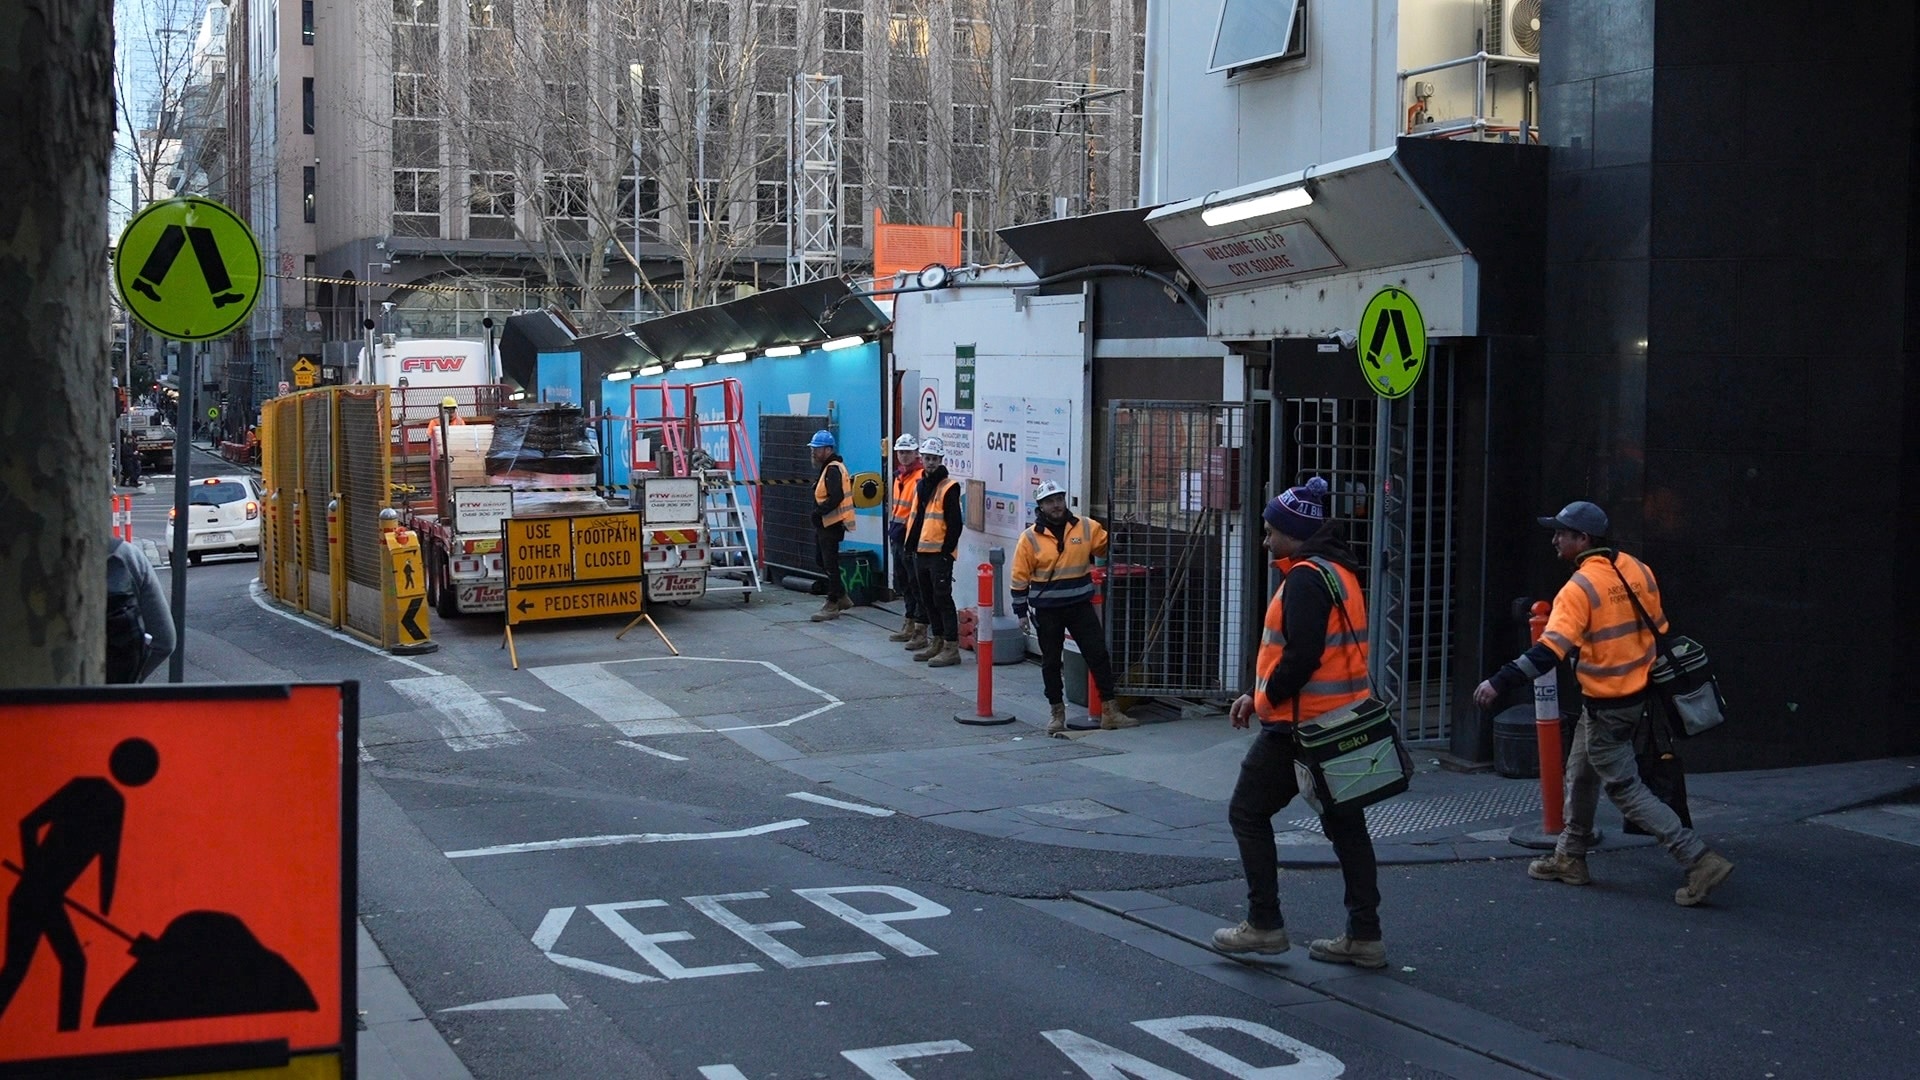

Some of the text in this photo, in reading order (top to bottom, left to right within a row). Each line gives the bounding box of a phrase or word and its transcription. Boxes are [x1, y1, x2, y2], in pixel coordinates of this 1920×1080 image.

[1203, 233, 1287, 261] WELCOME TO CYP
[1228, 254, 1294, 277] CITY SQUARE
[401, 355, 468, 373] FTW
[926, 398, 932, 422] 5
[944, 416, 966, 427] NOTICE
[987, 431, 1016, 453] GATE
[998, 463, 1003, 481] 1
[526, 524, 551, 539] USE
[577, 527, 637, 545] FOOTPATH
[518, 544, 561, 560] OTHER
[585, 550, 631, 568] CLOSED
[511, 563, 571, 581] FOOTPATH
[663, 575, 702, 591] TUFF
[545, 590, 638, 612] PEDESTRIANS
